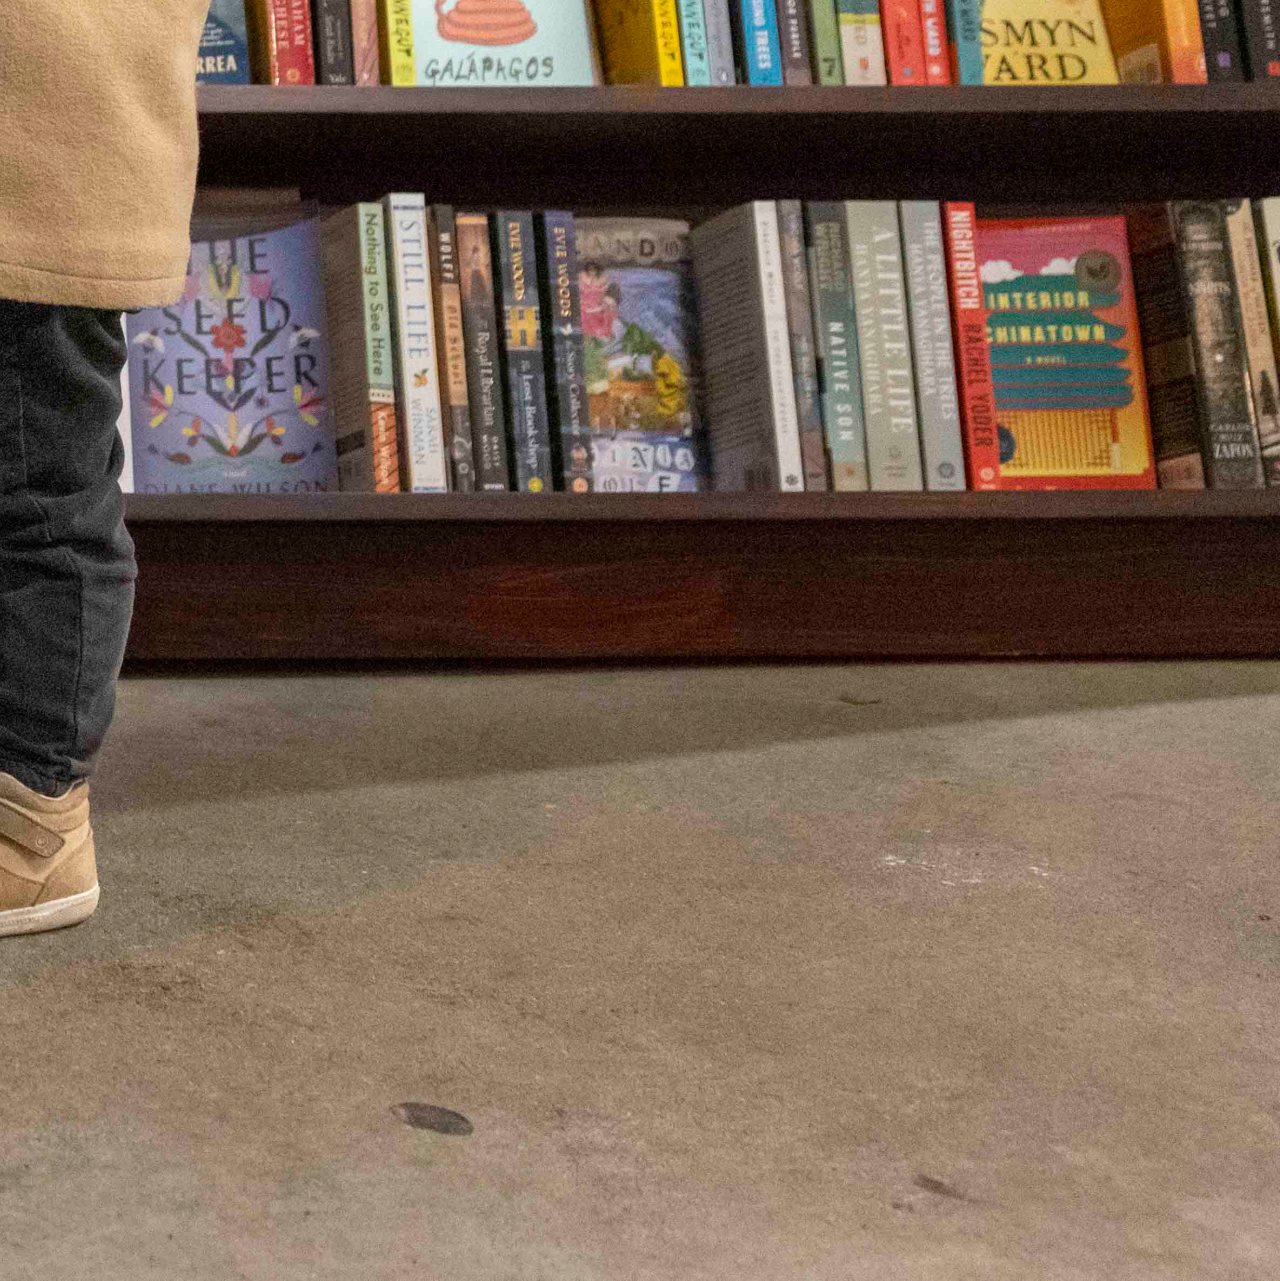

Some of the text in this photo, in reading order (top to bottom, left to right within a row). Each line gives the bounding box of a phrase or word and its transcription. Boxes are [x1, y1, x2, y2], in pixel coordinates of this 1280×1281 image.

[424, 50, 555, 83] GALÁPAGOS
[363, 212, 386, 377] Nothing to See Here
[399, 220, 429, 360] STILL LIFE
[439, 232, 453, 280] WOLFF
[475, 331, 495, 426] Royal Librarian
[828, 321, 854, 441] NATIVE SON
[873, 253, 914, 433] LITTLE LIFE
[950, 210, 994, 447] NIGHTBITCH RACHEL YODER
